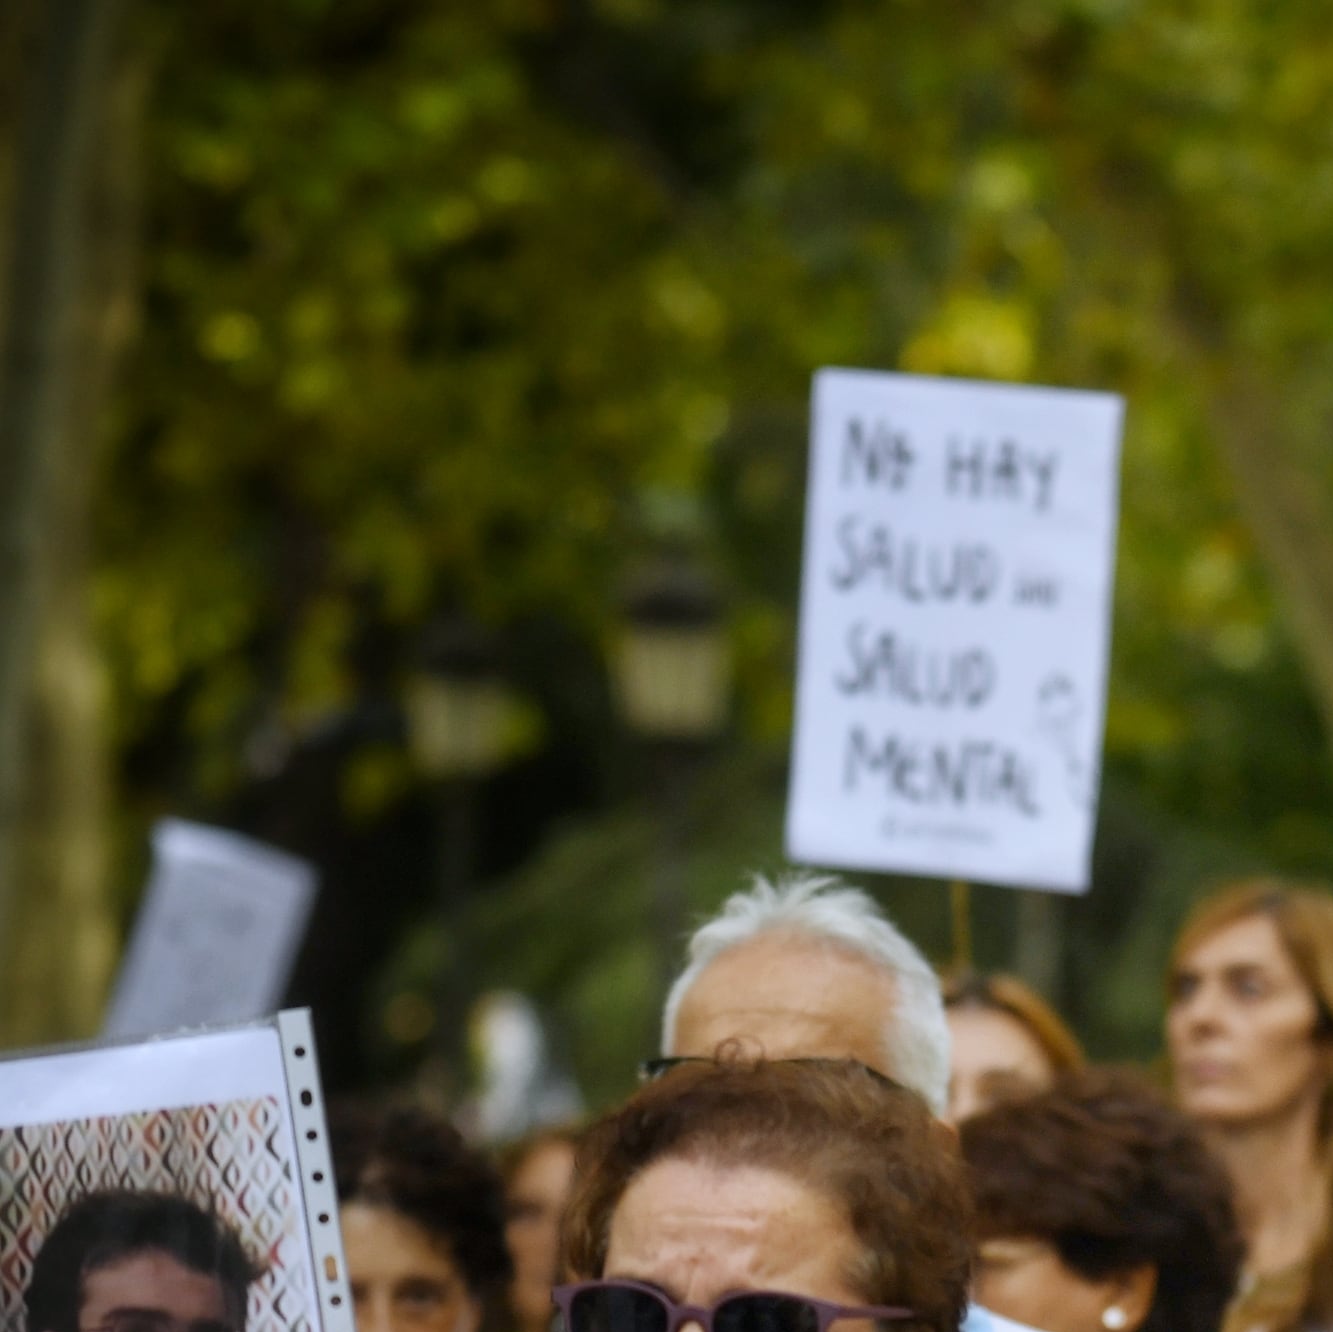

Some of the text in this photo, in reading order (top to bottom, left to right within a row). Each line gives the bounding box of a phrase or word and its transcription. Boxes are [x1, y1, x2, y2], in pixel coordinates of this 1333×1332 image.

[839, 415, 1058, 513] NO HAY
[830, 513, 998, 604] SALUD
[834, 620, 997, 708] SALUD
[844, 724, 1042, 818] MENTAL
